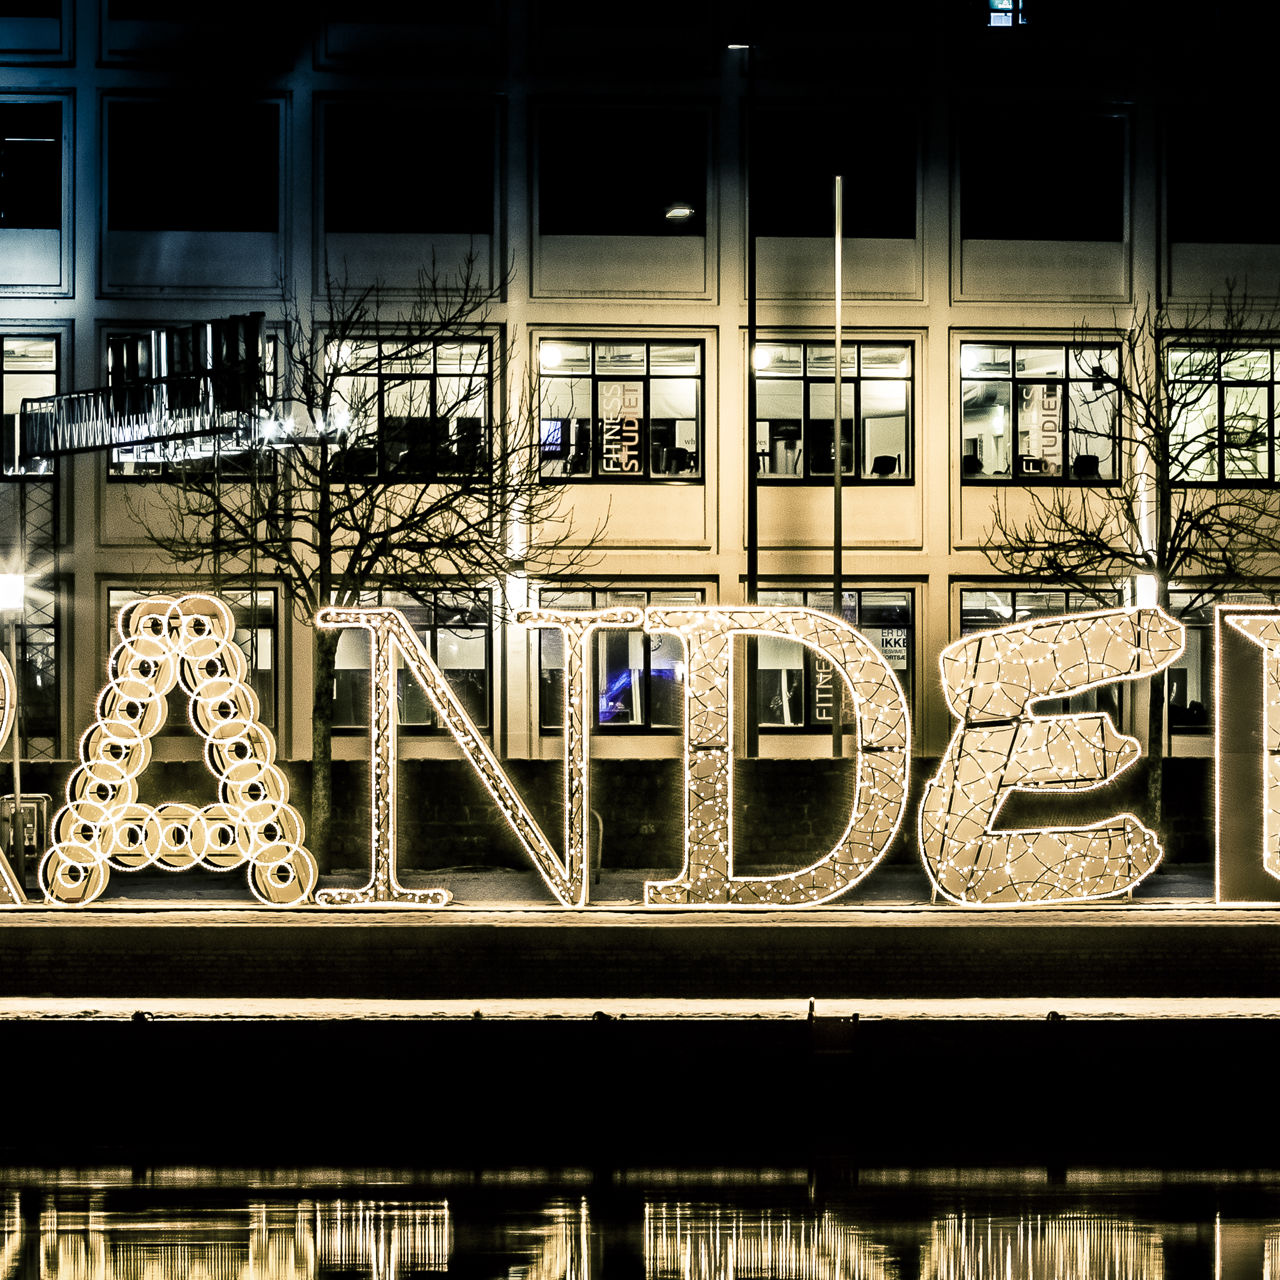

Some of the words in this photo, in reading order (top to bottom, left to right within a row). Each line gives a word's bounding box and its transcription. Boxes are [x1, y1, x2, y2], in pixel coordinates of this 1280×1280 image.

[603, 384, 621, 471] FITNESS
[622, 384, 639, 472] STUDIET
[1041, 386, 1058, 473] STUDIET
[815, 651, 834, 720] FITNE
